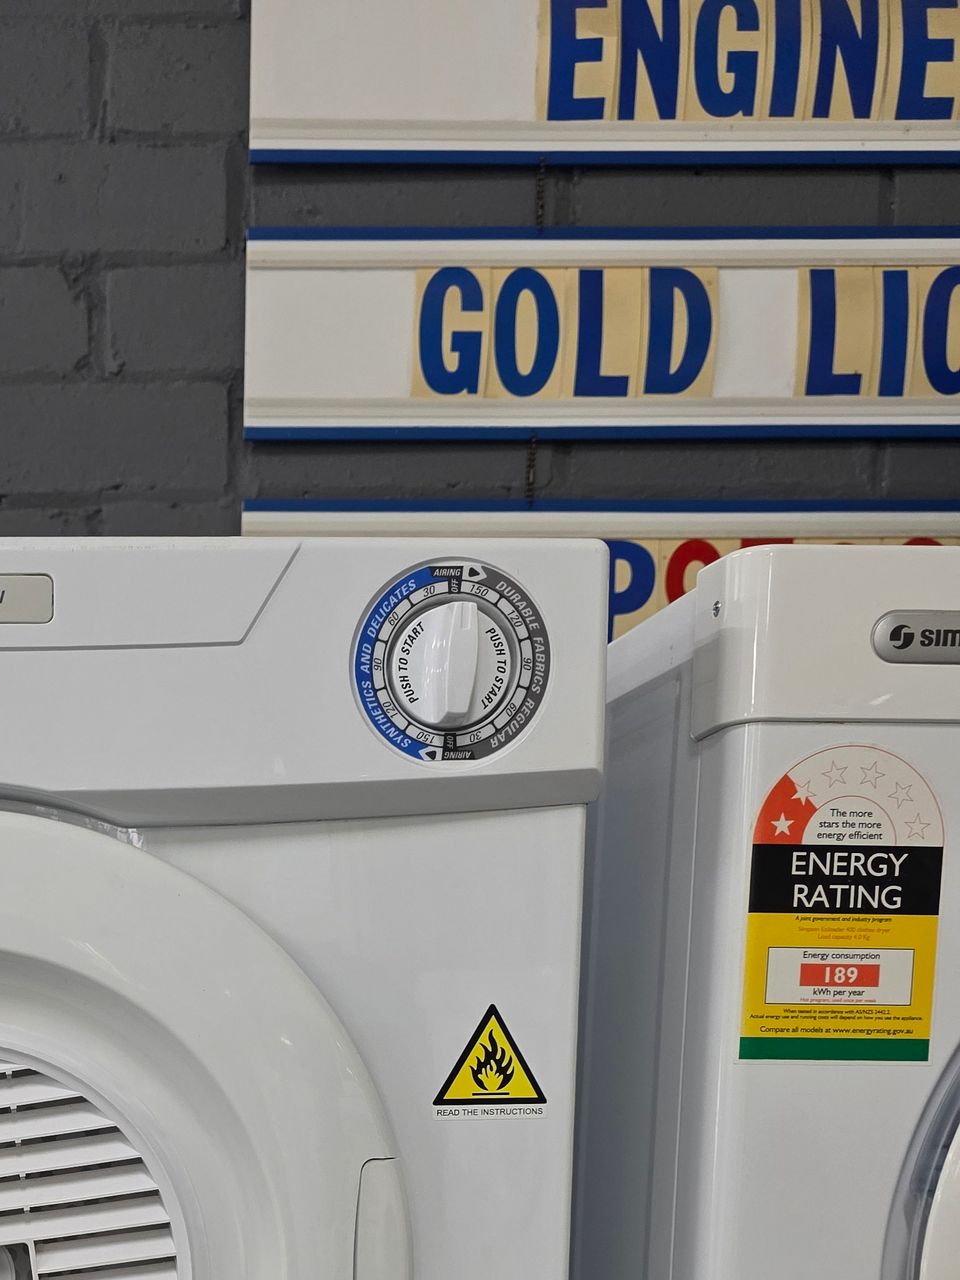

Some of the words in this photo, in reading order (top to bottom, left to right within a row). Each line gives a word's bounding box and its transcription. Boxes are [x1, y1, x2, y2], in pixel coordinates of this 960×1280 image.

[418, 266, 712, 397] GOLD
[433, 568, 461, 577] AIRING
[423, 585, 436, 597] 30
[451, 578, 459, 593] OFF
[469, 584, 489, 597] 150
[367, 579, 417, 637] DELICATES
[495, 581, 540, 631] DURABLE
[388, 611, 399, 626] 60
[507, 610, 523, 628] 120
[401, 621, 425, 656] START
[485, 627, 506, 656] PUSH
[361, 643, 372, 674] AND
[374, 657, 382, 671] 90
[399, 657, 408, 672] TO
[523, 657, 532, 671] 90
[531, 637, 545, 694] FABRICS
[497, 659, 507, 674] TO
[399, 674, 419, 704] PUSH
[481, 676, 504, 710] START
[361, 680, 412, 748] SYNTHETICS
[383, 701, 398, 718] 120
[506, 702, 517, 717] 60
[490, 698, 535, 748] REGULAR
[416, 731, 435, 742] 150
[446, 736, 454, 749] OFF
[469, 731, 482, 743] 30
[444, 751, 472, 759] AIRING
[830, 808, 847, 817] The
[842, 820, 856, 828] the
[817, 832, 846, 841] energy
[849, 831, 883, 840] efficient
[791, 851, 908, 877] ENERGY
[793, 884, 902, 909] RATING
[803, 951, 830, 961] Energy
[832, 951, 880, 961] consumption
[825, 967, 858, 984] 189
[813, 988, 831, 996] kWh
[833, 989, 846, 998] per
[848, 989, 865, 997] year
[760, 1026, 790, 1034] Compare
[481, 1108, 543, 1116] INSTRUCTIONS
